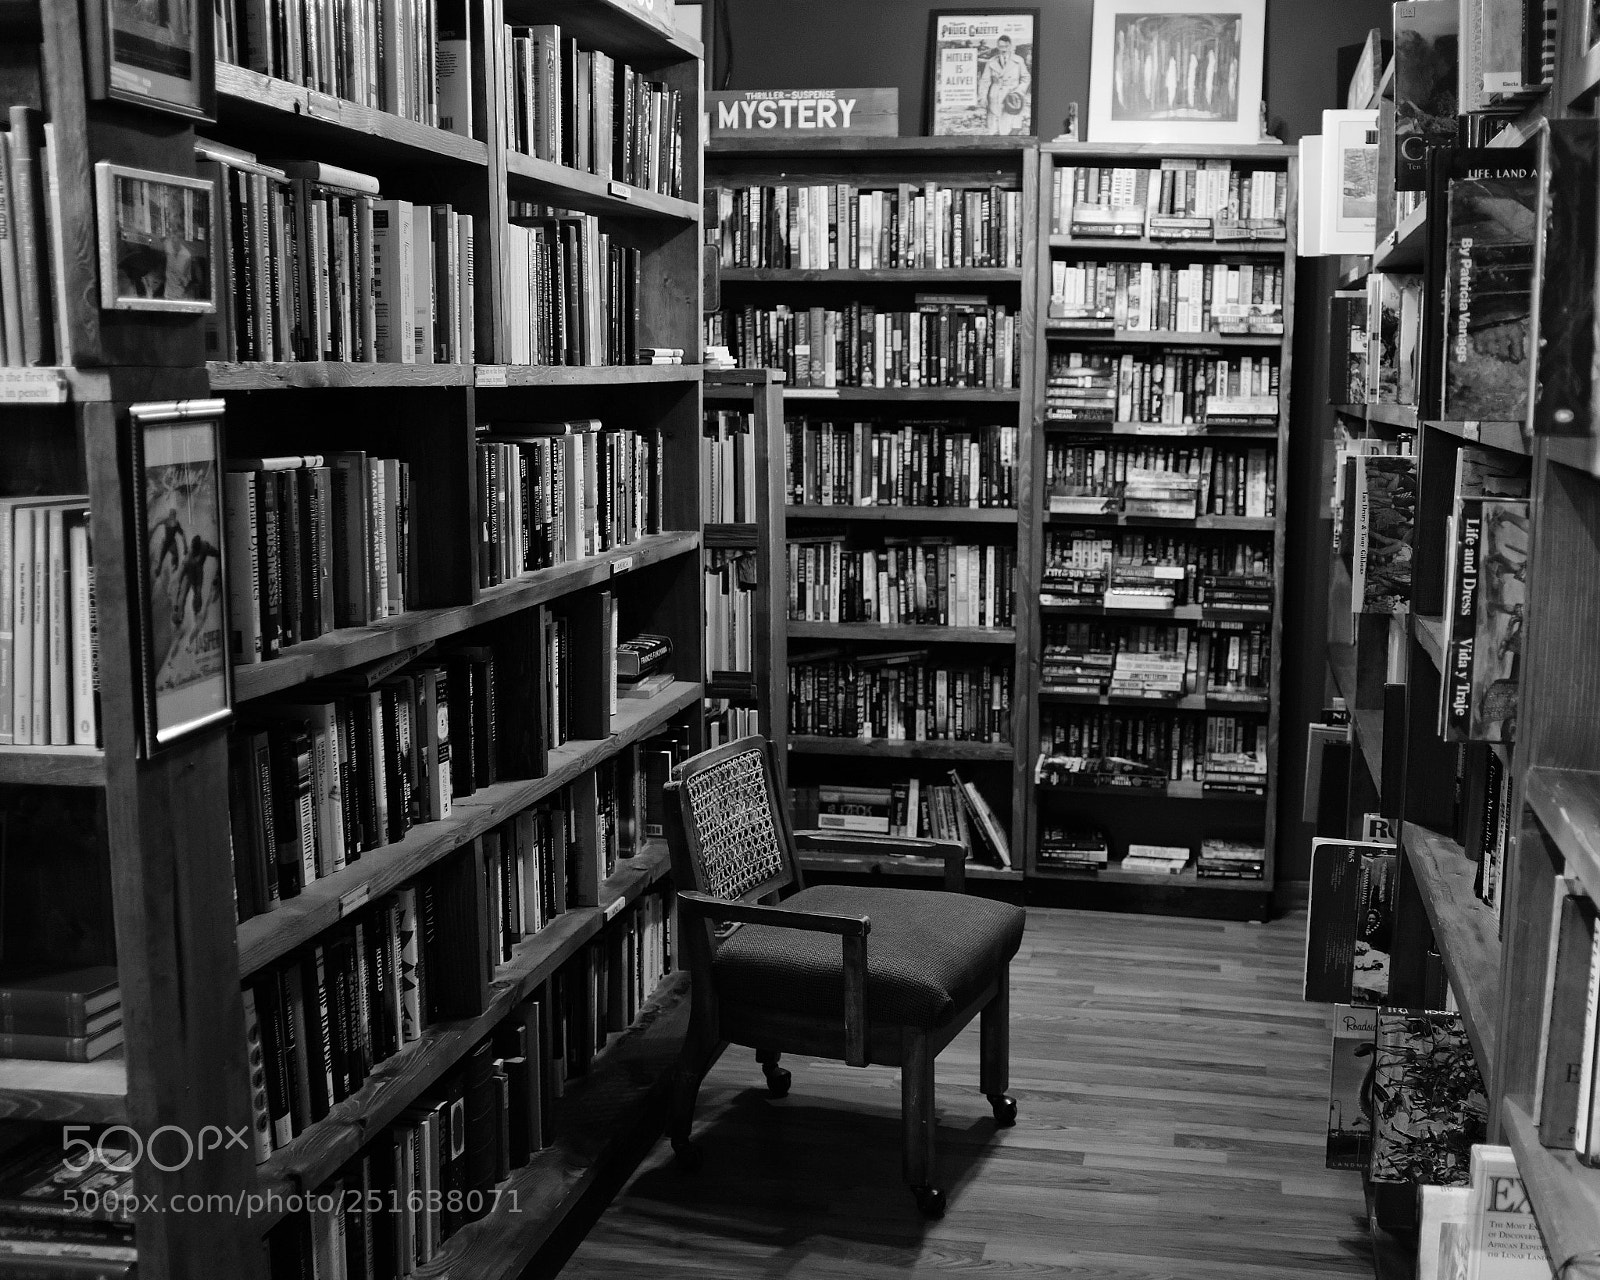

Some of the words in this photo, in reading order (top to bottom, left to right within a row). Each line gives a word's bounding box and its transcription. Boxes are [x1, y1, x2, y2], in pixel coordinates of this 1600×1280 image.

[946, 53, 973, 62] HITLER
[956, 65, 963, 73] IS
[946, 77, 973, 86] ALIVE!
[718, 99, 857, 129] MYSTERY
[1497, 169, 1527, 178] LAND
[262, 203, 270, 249] Customer
[1459, 237, 1473, 257] By
[264, 255, 272, 298] Centered
[1458, 258, 1473, 312] Patricia
[1457, 313, 1471, 364] Vanags
[249, 480, 257, 529] Human
[1465, 518, 1480, 546] Life
[248, 535, 260, 601] Dynamics
[266, 524, 278, 607] BUSINESS
[1463, 548, 1477, 574] and
[1461, 578, 1477, 616] Dress
[90, 632, 101, 692] PHILOSOPHY
[1457, 637, 1473, 668] Vida
[1455, 671, 1468, 680] y
[1452, 682, 1471, 716] Traje
[376, 948, 384, 992] RIGGED
[1332, 1161, 1370, 1169] LANDMA
[1487, 1176, 1533, 1214] EX
